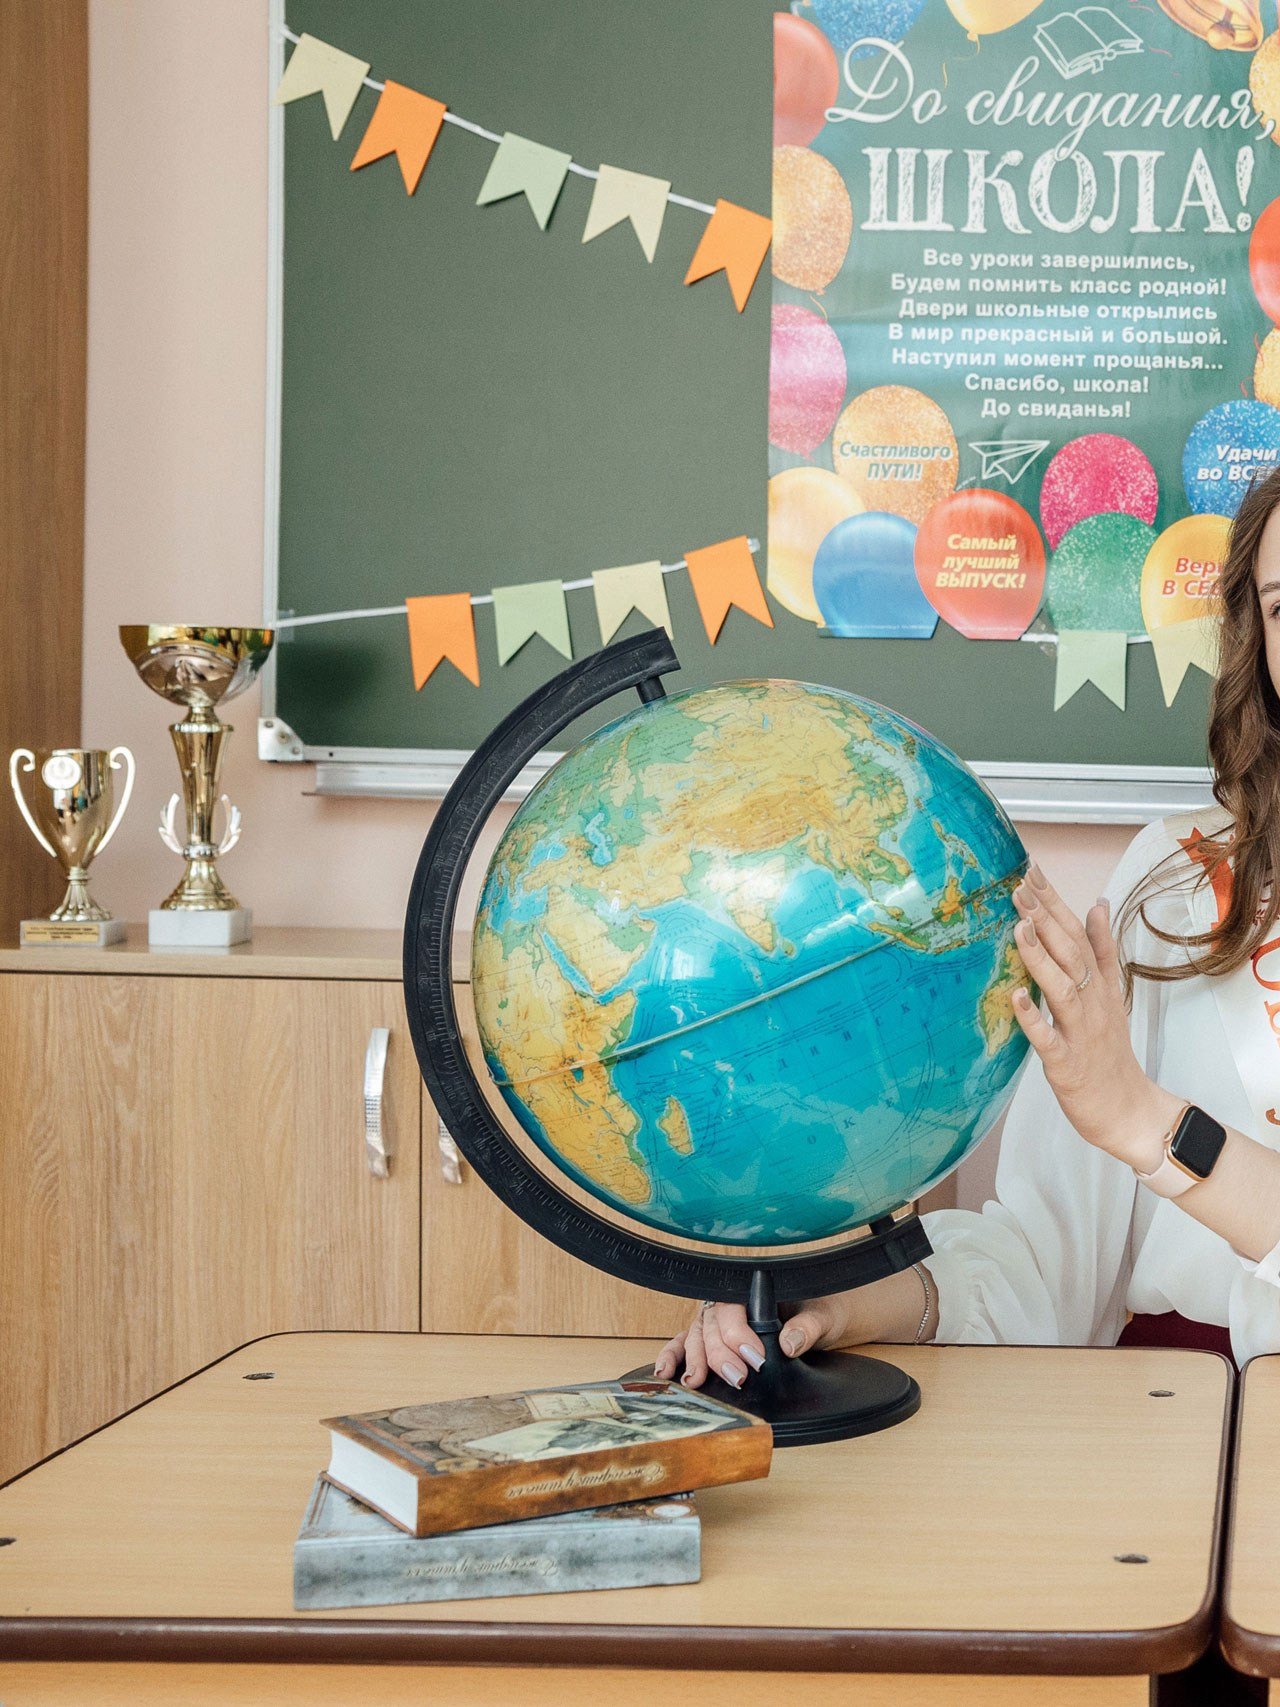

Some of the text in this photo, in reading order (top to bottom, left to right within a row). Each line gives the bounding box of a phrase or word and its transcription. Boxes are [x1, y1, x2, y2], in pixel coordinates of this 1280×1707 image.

[824, 37, 1276, 161] До свидания,
[861, 144, 1254, 233] ШКОЛА!
[924, 249, 1194, 272] Все уроки завершились,
[892, 273, 1226, 297] Будем помнить класс родной!
[899, 301, 1217, 323] Двери школьные открылись
[889, 324, 1227, 344] В мир прекрасный и большой.
[893, 348, 1222, 371] Наступил момент прощанья...
[965, 374, 1148, 393] Спасибо, школа!
[981, 399, 1130, 419] До свиданья!
[839, 440, 951, 462] Счастливого
[1216, 445, 1278, 462] Удачи
[867, 462, 923, 481] ПУТИ!
[1197, 467, 1222, 480] во
[946, 533, 1017, 551] Самый
[942, 553, 1020, 574] лучший
[935, 572, 1026, 590] ВЫПУСК!
[1162, 580, 1176, 595] В
